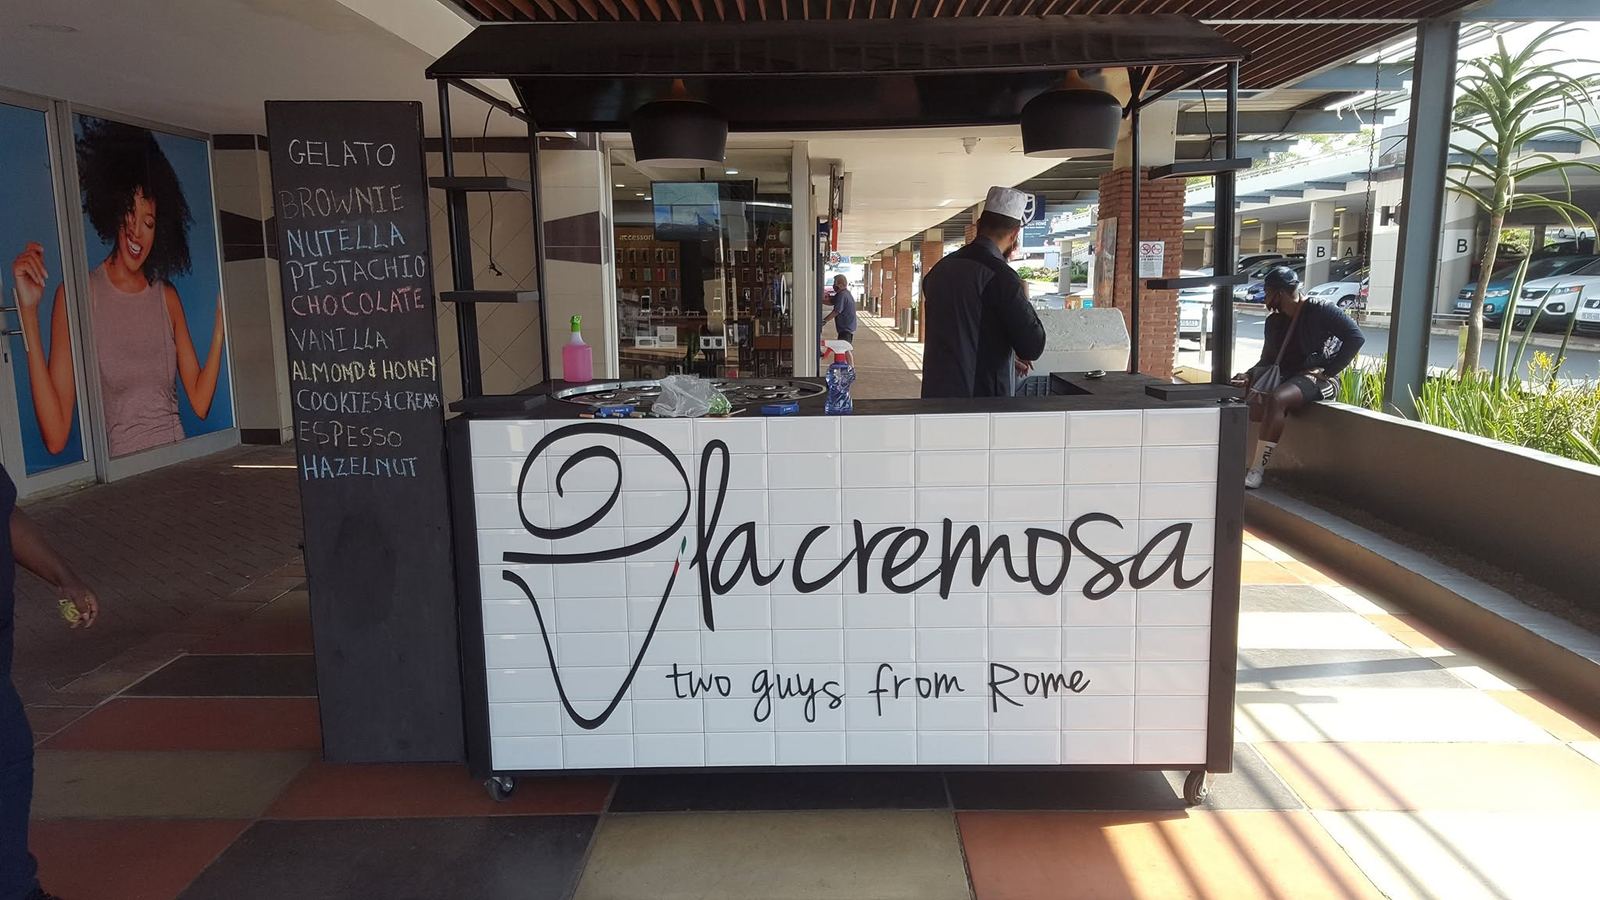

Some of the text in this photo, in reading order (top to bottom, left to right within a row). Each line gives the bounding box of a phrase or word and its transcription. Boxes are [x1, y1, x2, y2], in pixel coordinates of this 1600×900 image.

[288, 138, 396, 167] GELATO
[278, 183, 404, 219] BROWNIE
[287, 221, 406, 258] NUTELLA
[1316, 246, 1326, 258] B
[1344, 246, 1354, 257] A
[1456, 238, 1468, 253] B
[286, 254, 426, 292] PISTACHIO
[291, 286, 425, 317] CHOCOLATE
[290, 327, 389, 353] VANILLA
[293, 359, 366, 383] ALMOND
[382, 356, 437, 382] HONEY
[299, 420, 403, 448] ESPESSO
[302, 454, 419, 480] HAZELNUT
[689, 438, 1213, 633] la cremosa
[665, 661, 1092, 723] two guys from Rome
